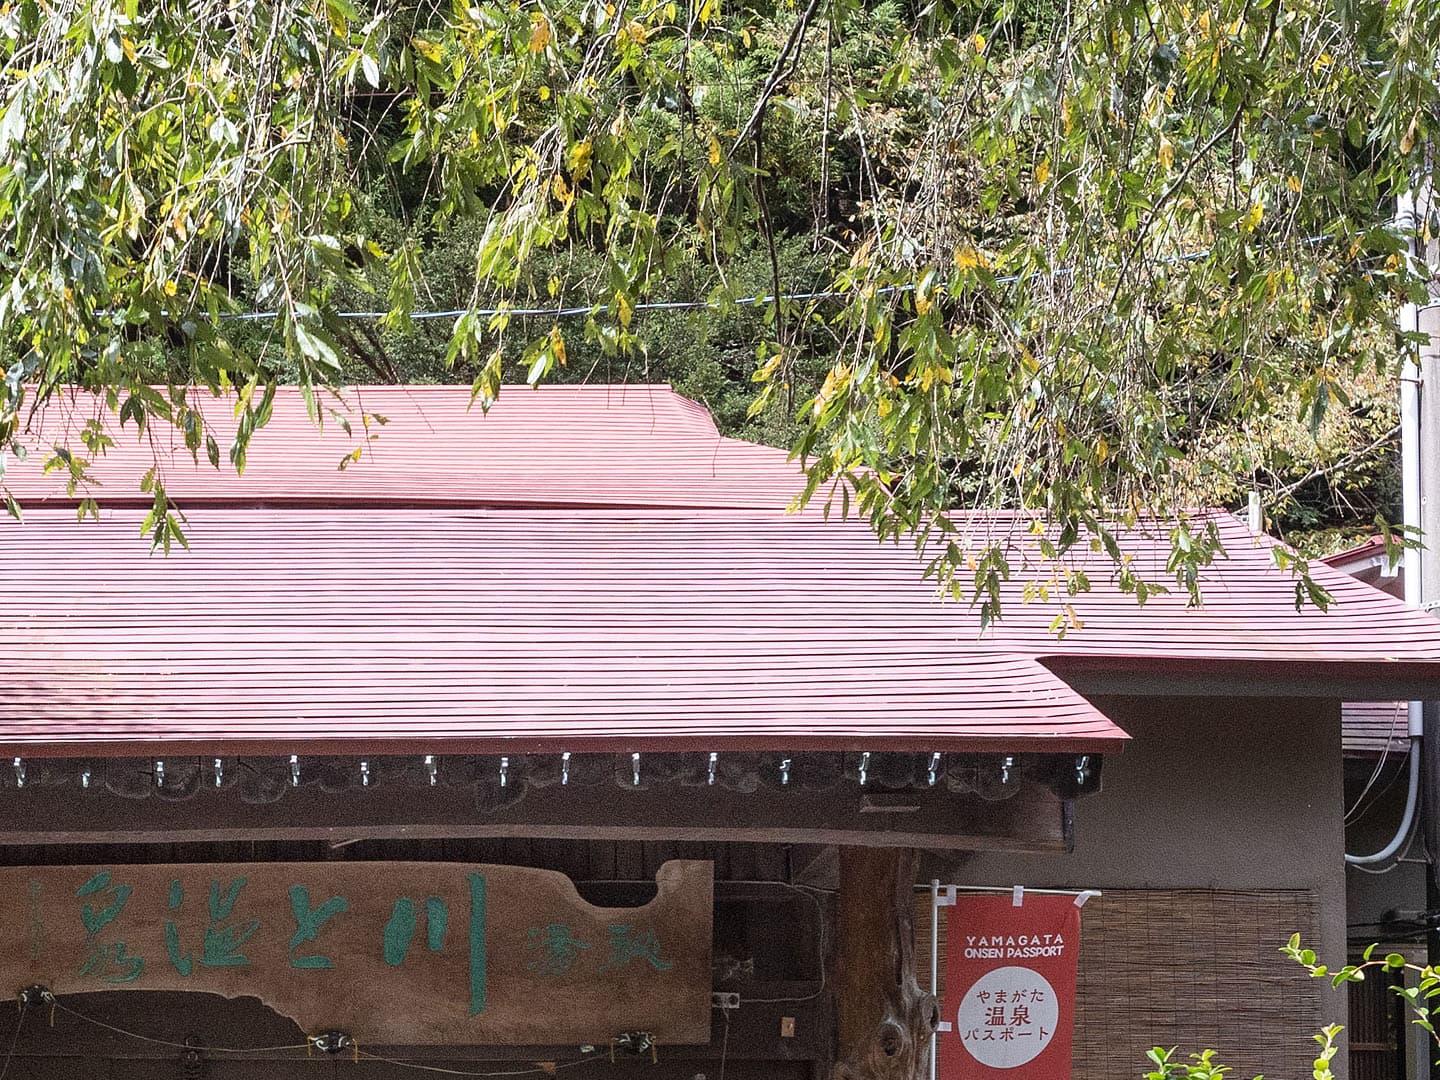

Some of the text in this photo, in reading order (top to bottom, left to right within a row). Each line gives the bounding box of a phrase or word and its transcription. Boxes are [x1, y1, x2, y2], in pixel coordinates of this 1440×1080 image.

[966, 934, 1064, 946] YAMAGATA
[964, 945, 1064, 959] ONSEN PASSPORT
[976, 988, 1045, 1004] やまがた
[984, 1004, 1032, 1027] 温泉
[964, 1026, 1049, 1042] パスポート
